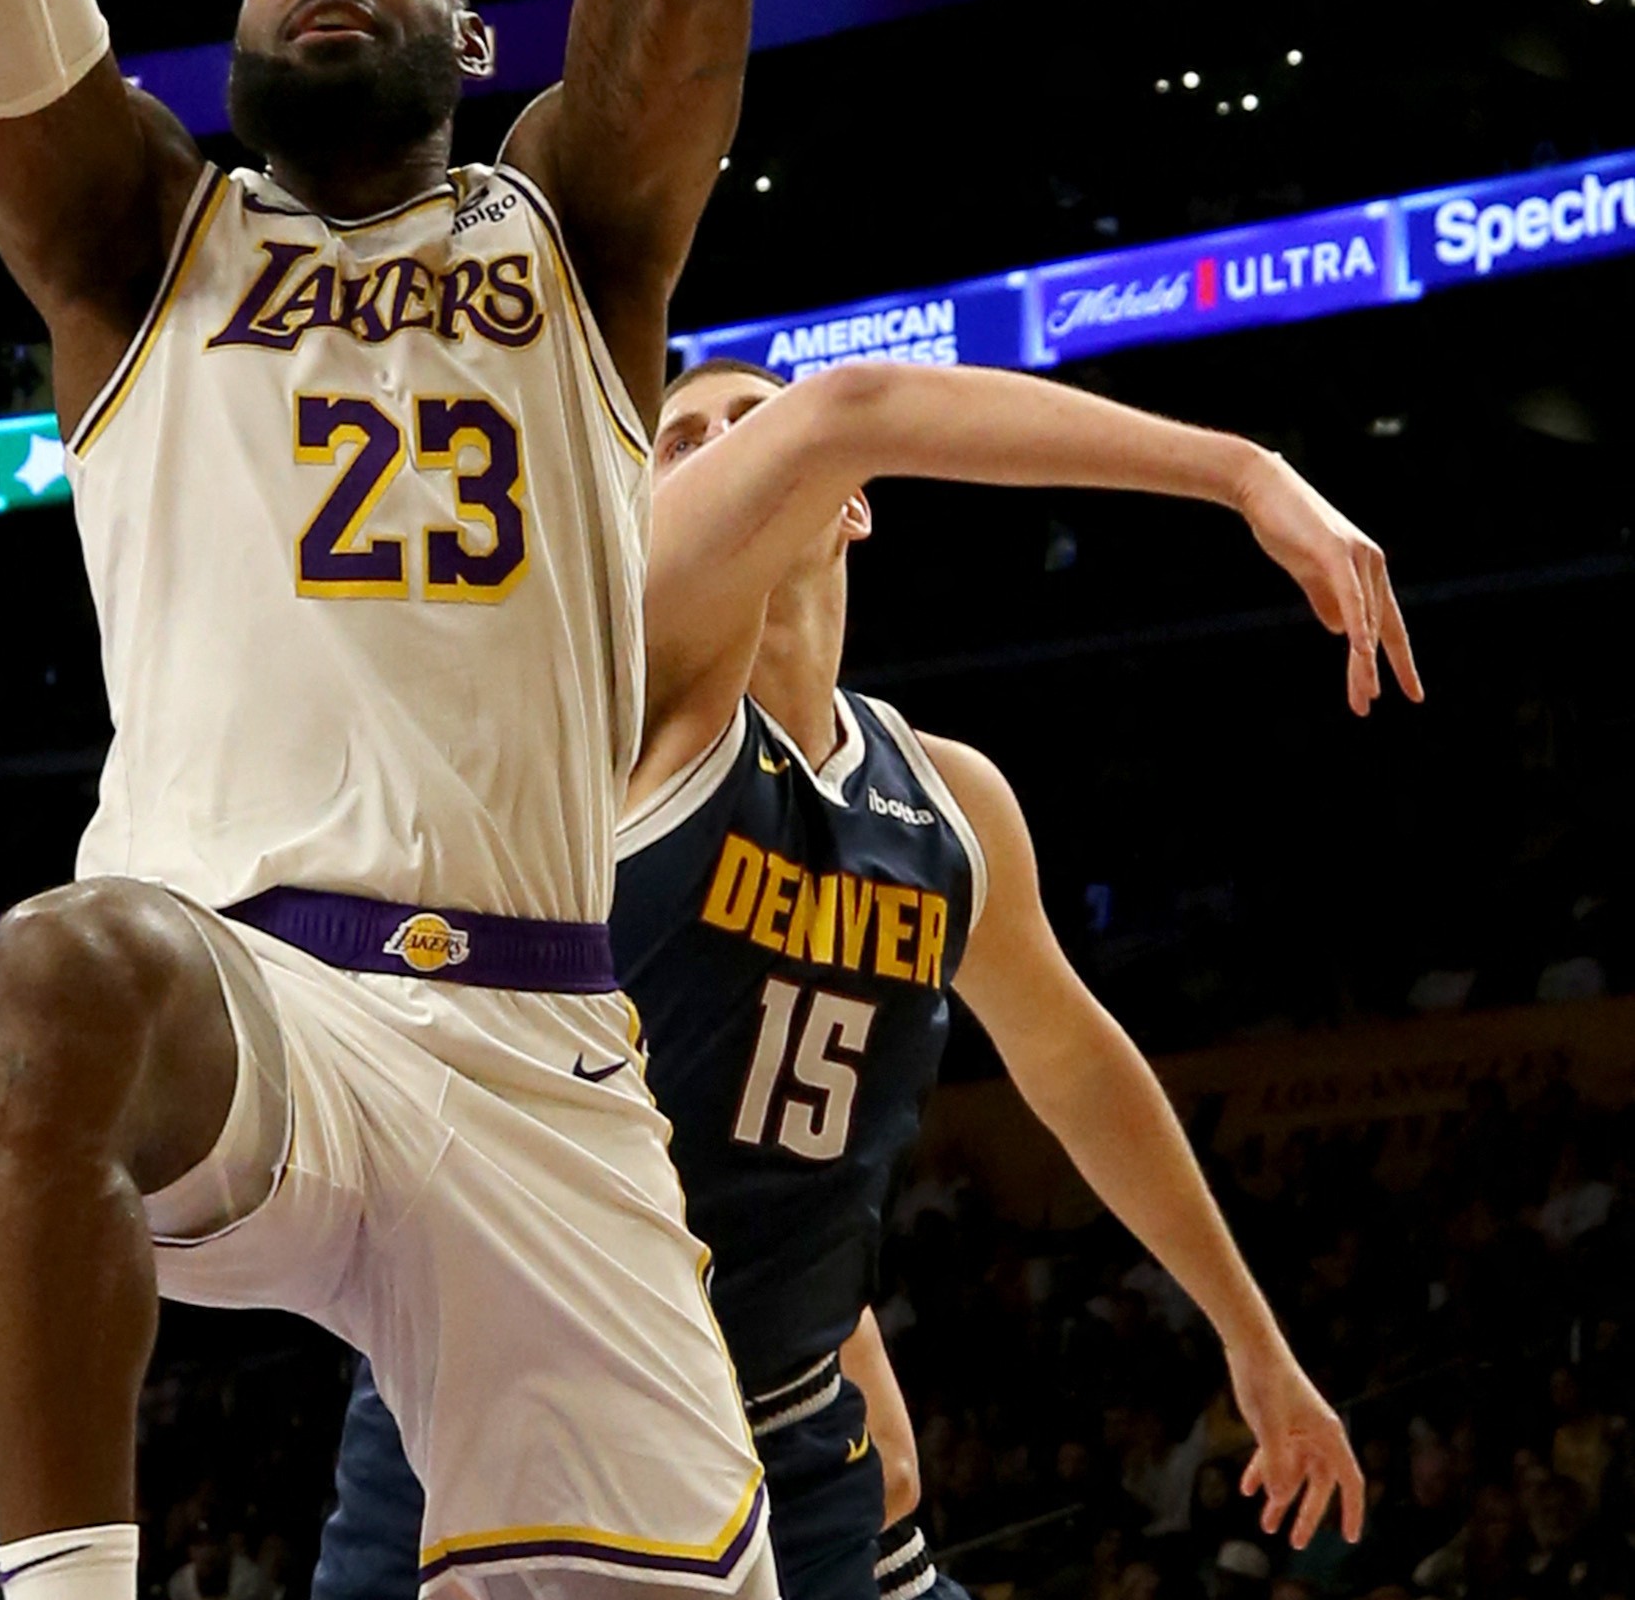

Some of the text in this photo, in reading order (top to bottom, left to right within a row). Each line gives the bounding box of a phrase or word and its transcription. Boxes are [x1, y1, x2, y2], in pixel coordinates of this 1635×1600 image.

[451, 194, 517, 236] ibigo
[202, 239, 546, 354] LAKERS
[1225, 236, 1375, 300] ULTRA
[767, 299, 955, 367] AMERICAN
[293, 391, 531, 604] 23
[867, 786, 935, 828] ibotta
[699, 831, 947, 990] DENVER
[733, 977, 877, 1162] 15
